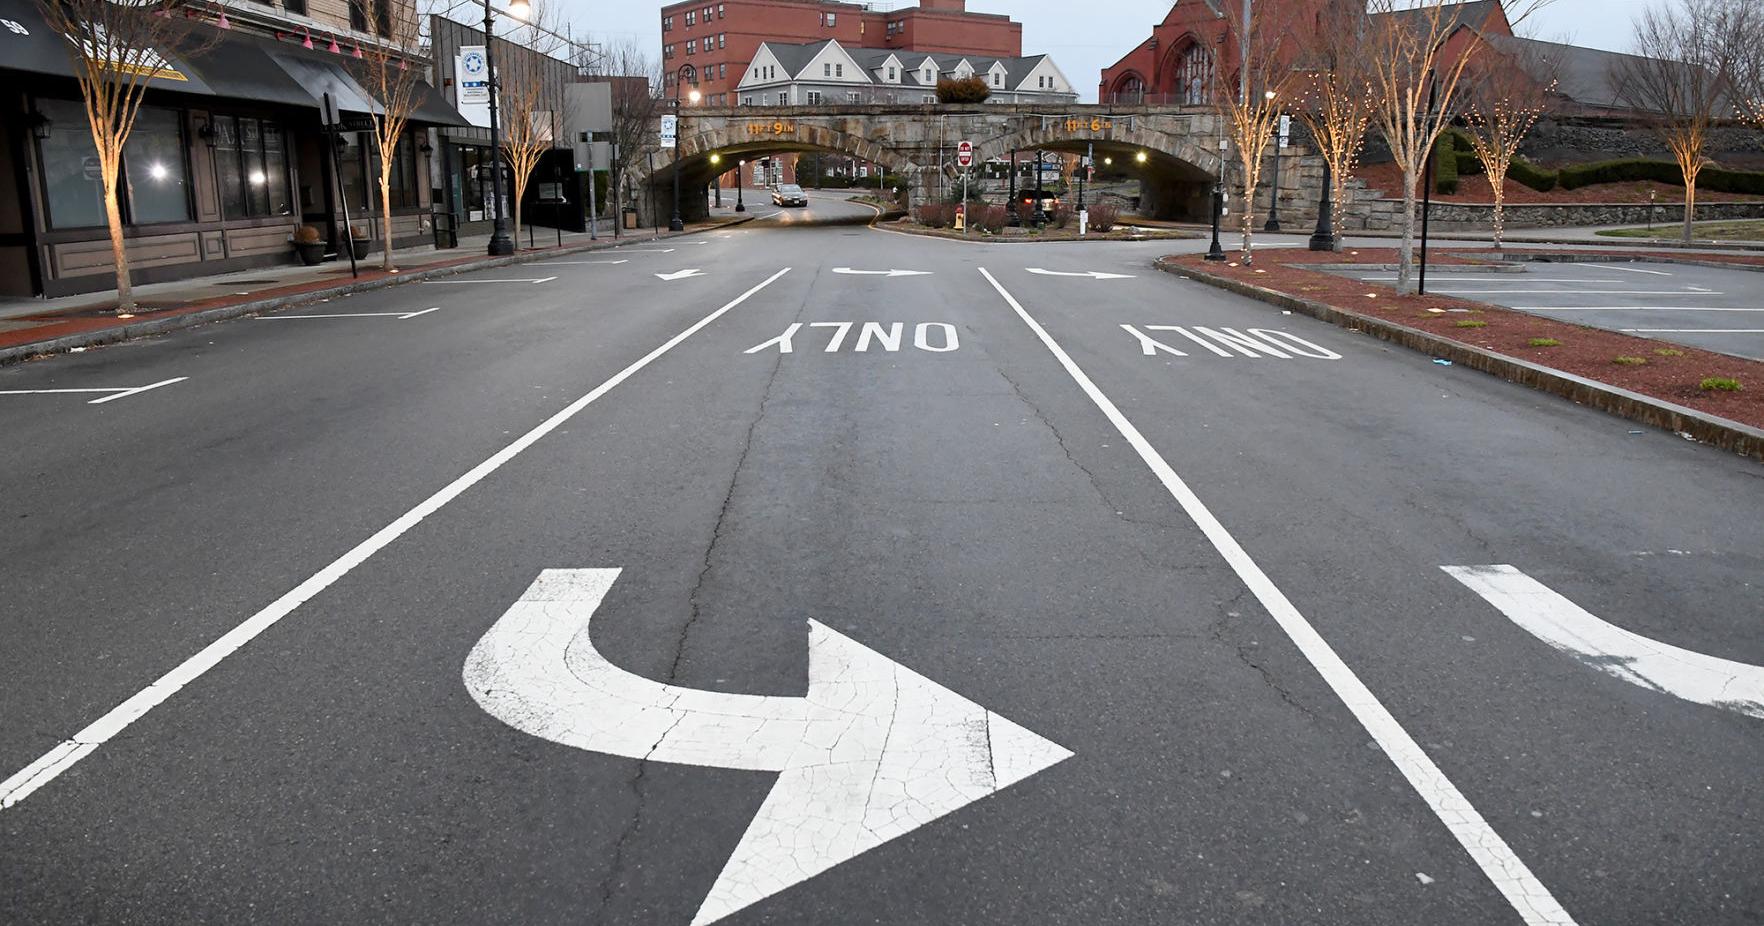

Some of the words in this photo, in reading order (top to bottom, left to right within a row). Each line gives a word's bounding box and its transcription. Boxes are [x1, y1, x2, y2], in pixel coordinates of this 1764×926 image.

[0, 19, 30, 35] 59
[743, 322, 960, 353] ONLY
[1119, 324, 1343, 360] ONLY
